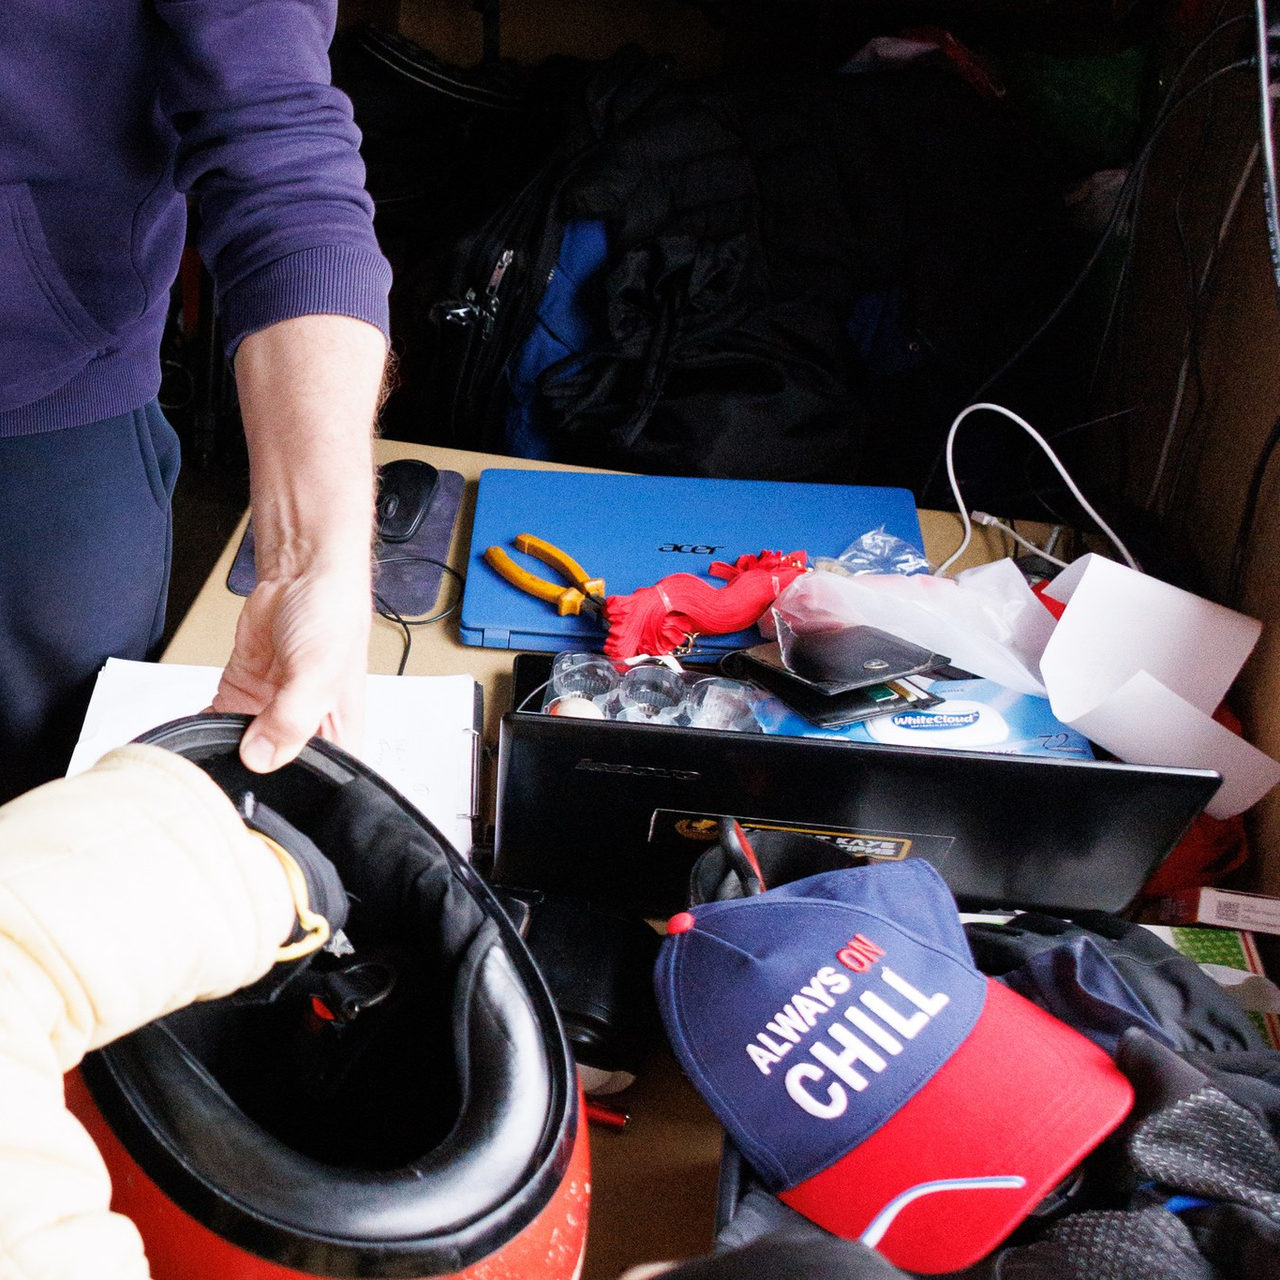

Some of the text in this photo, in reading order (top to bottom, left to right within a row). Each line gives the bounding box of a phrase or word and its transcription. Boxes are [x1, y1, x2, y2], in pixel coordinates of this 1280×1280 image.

[658, 543, 725, 555] acer
[894, 713, 975, 726] WhiteCloud
[746, 933, 887, 1076] ALWAYS ON
[784, 966, 951, 1120] CHILL
